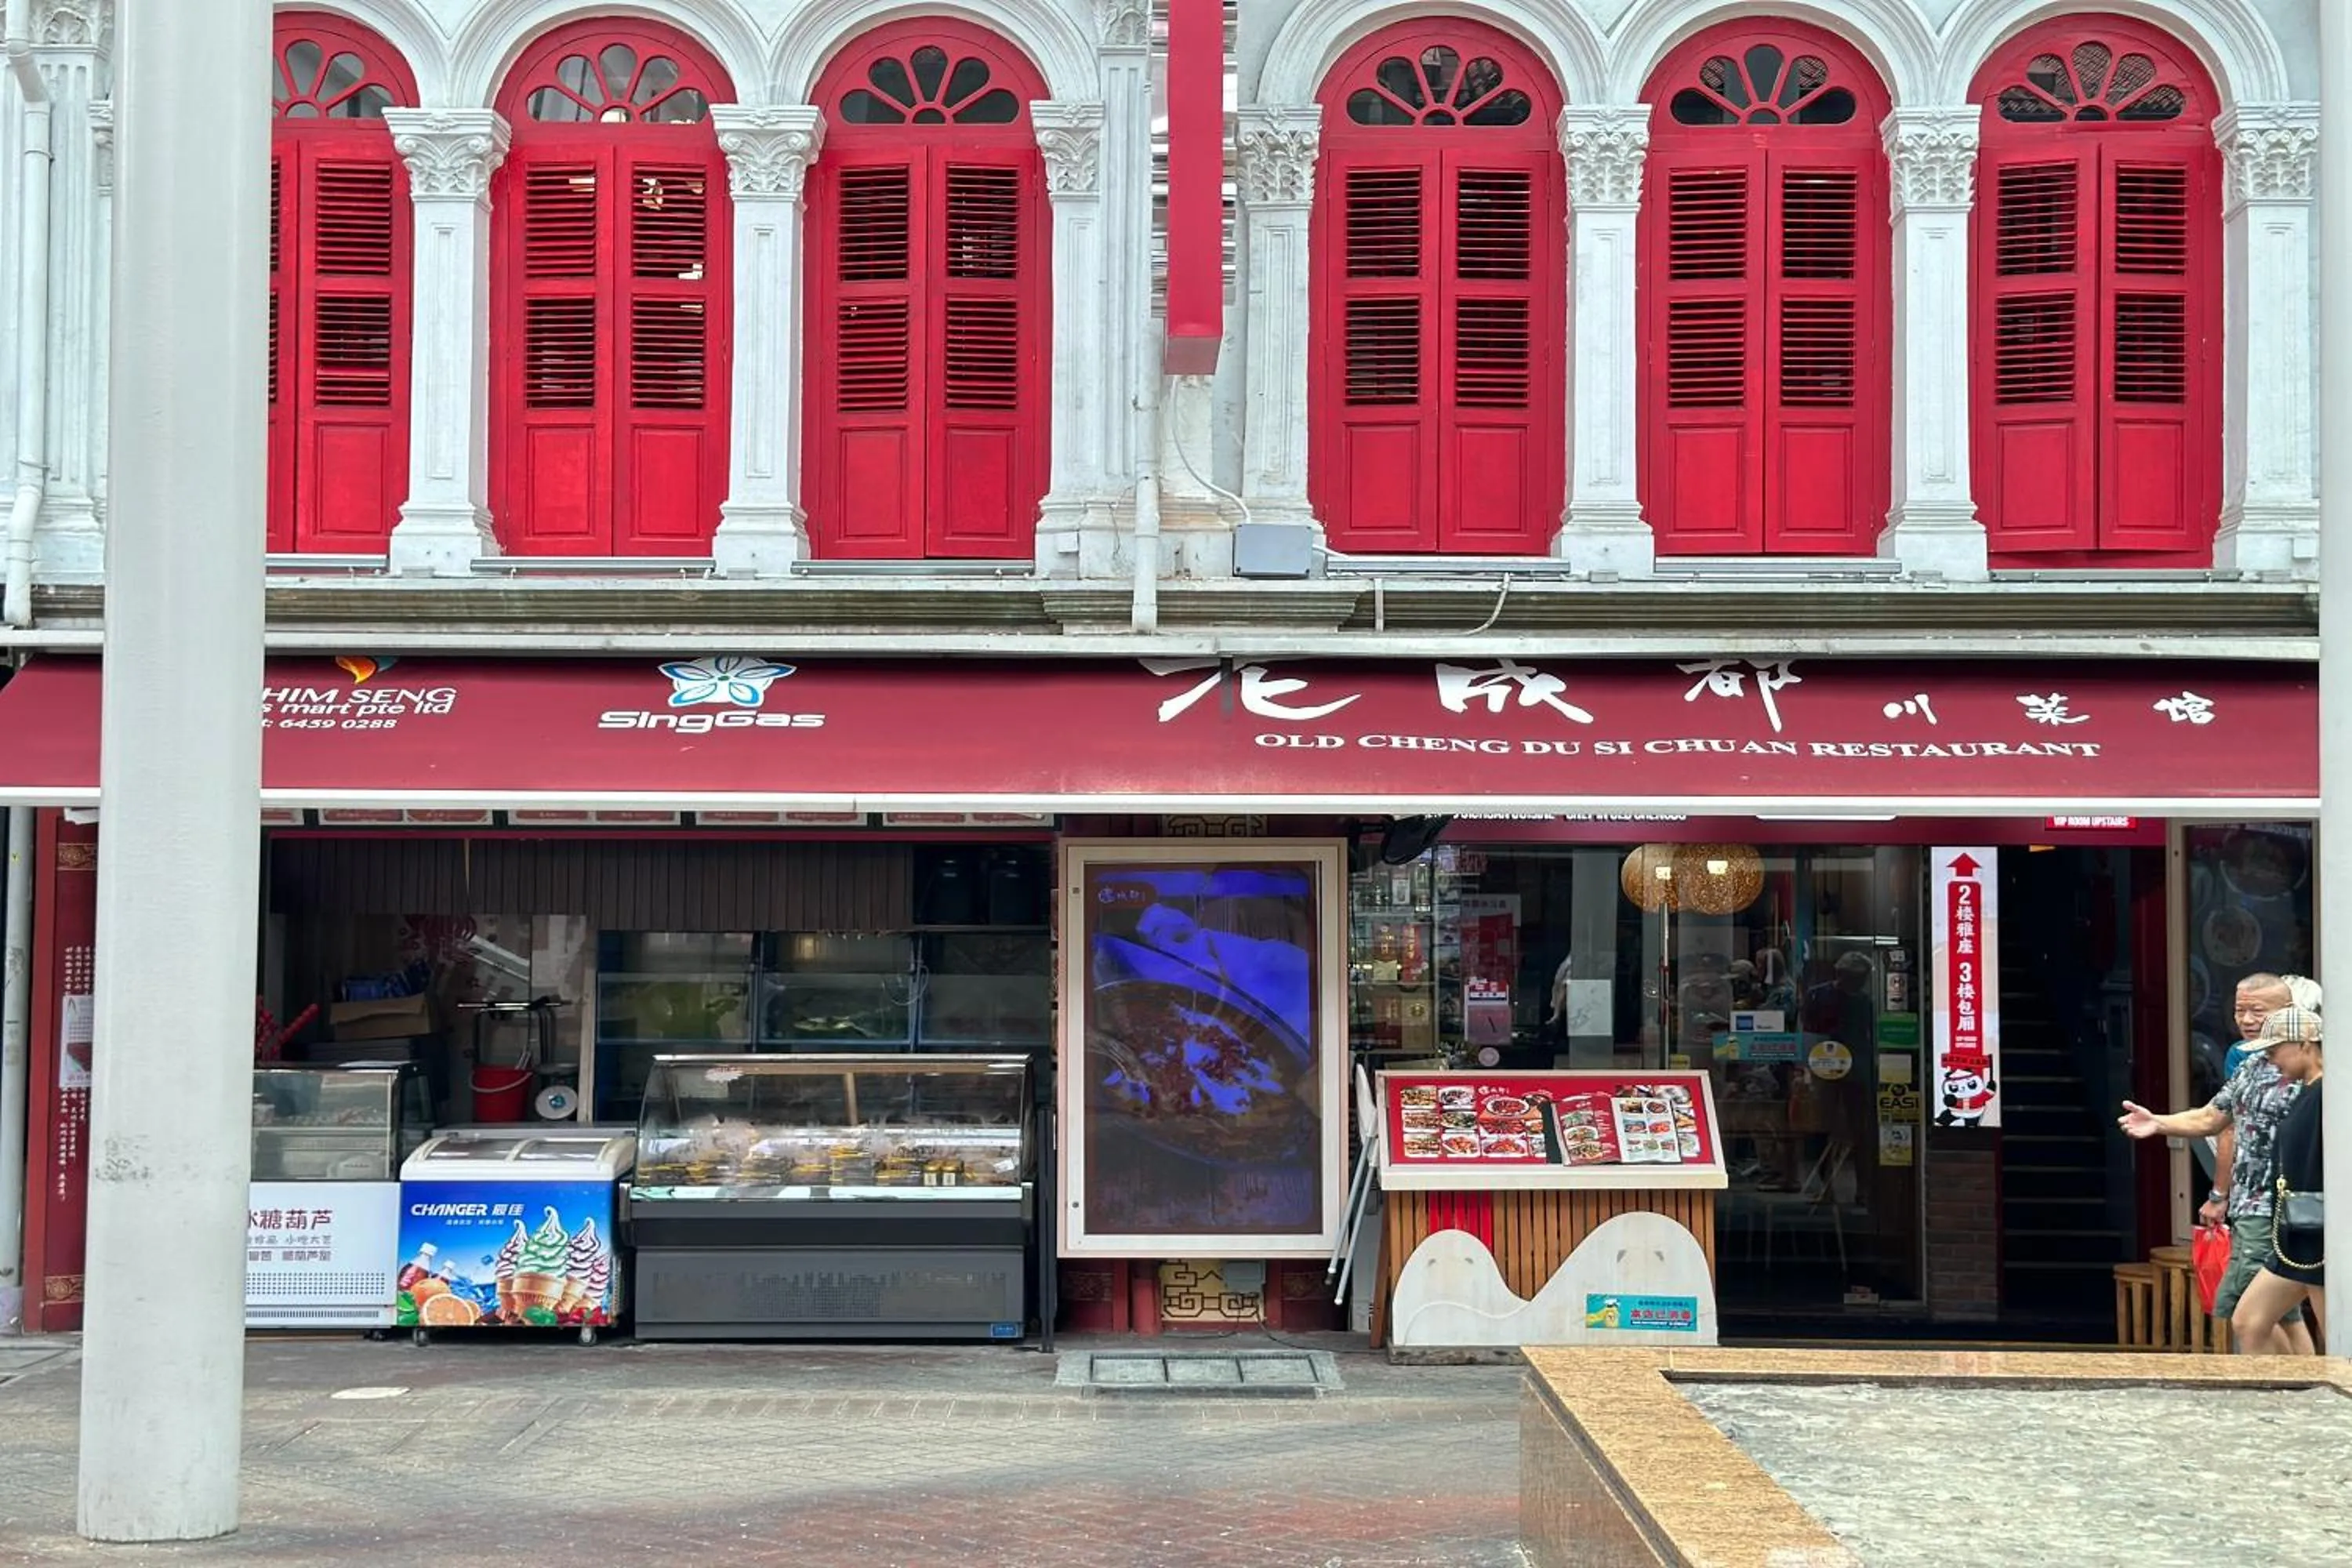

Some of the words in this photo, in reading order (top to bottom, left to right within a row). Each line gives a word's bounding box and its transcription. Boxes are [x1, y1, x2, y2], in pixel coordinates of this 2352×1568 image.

[262, 688, 339, 703] HIM
[347, 687, 457, 703] SENG
[281, 702, 352, 715] mart
[356, 702, 406, 717] pte
[414, 699, 454, 714] ltd
[279, 719, 336, 729] 6459
[340, 719, 398, 730] 0288
[597, 710, 826, 734] SingGas
[1254, 733, 1345, 749] OLD
[1357, 734, 1513, 754] CHENG
[1522, 740, 1582, 755] DU
[1593, 740, 1634, 755] SI
[1643, 739, 1798, 756] CHUAN
[1808, 741, 2103, 757] RESTAURANT
[411, 1203, 488, 1216] CHANGER
